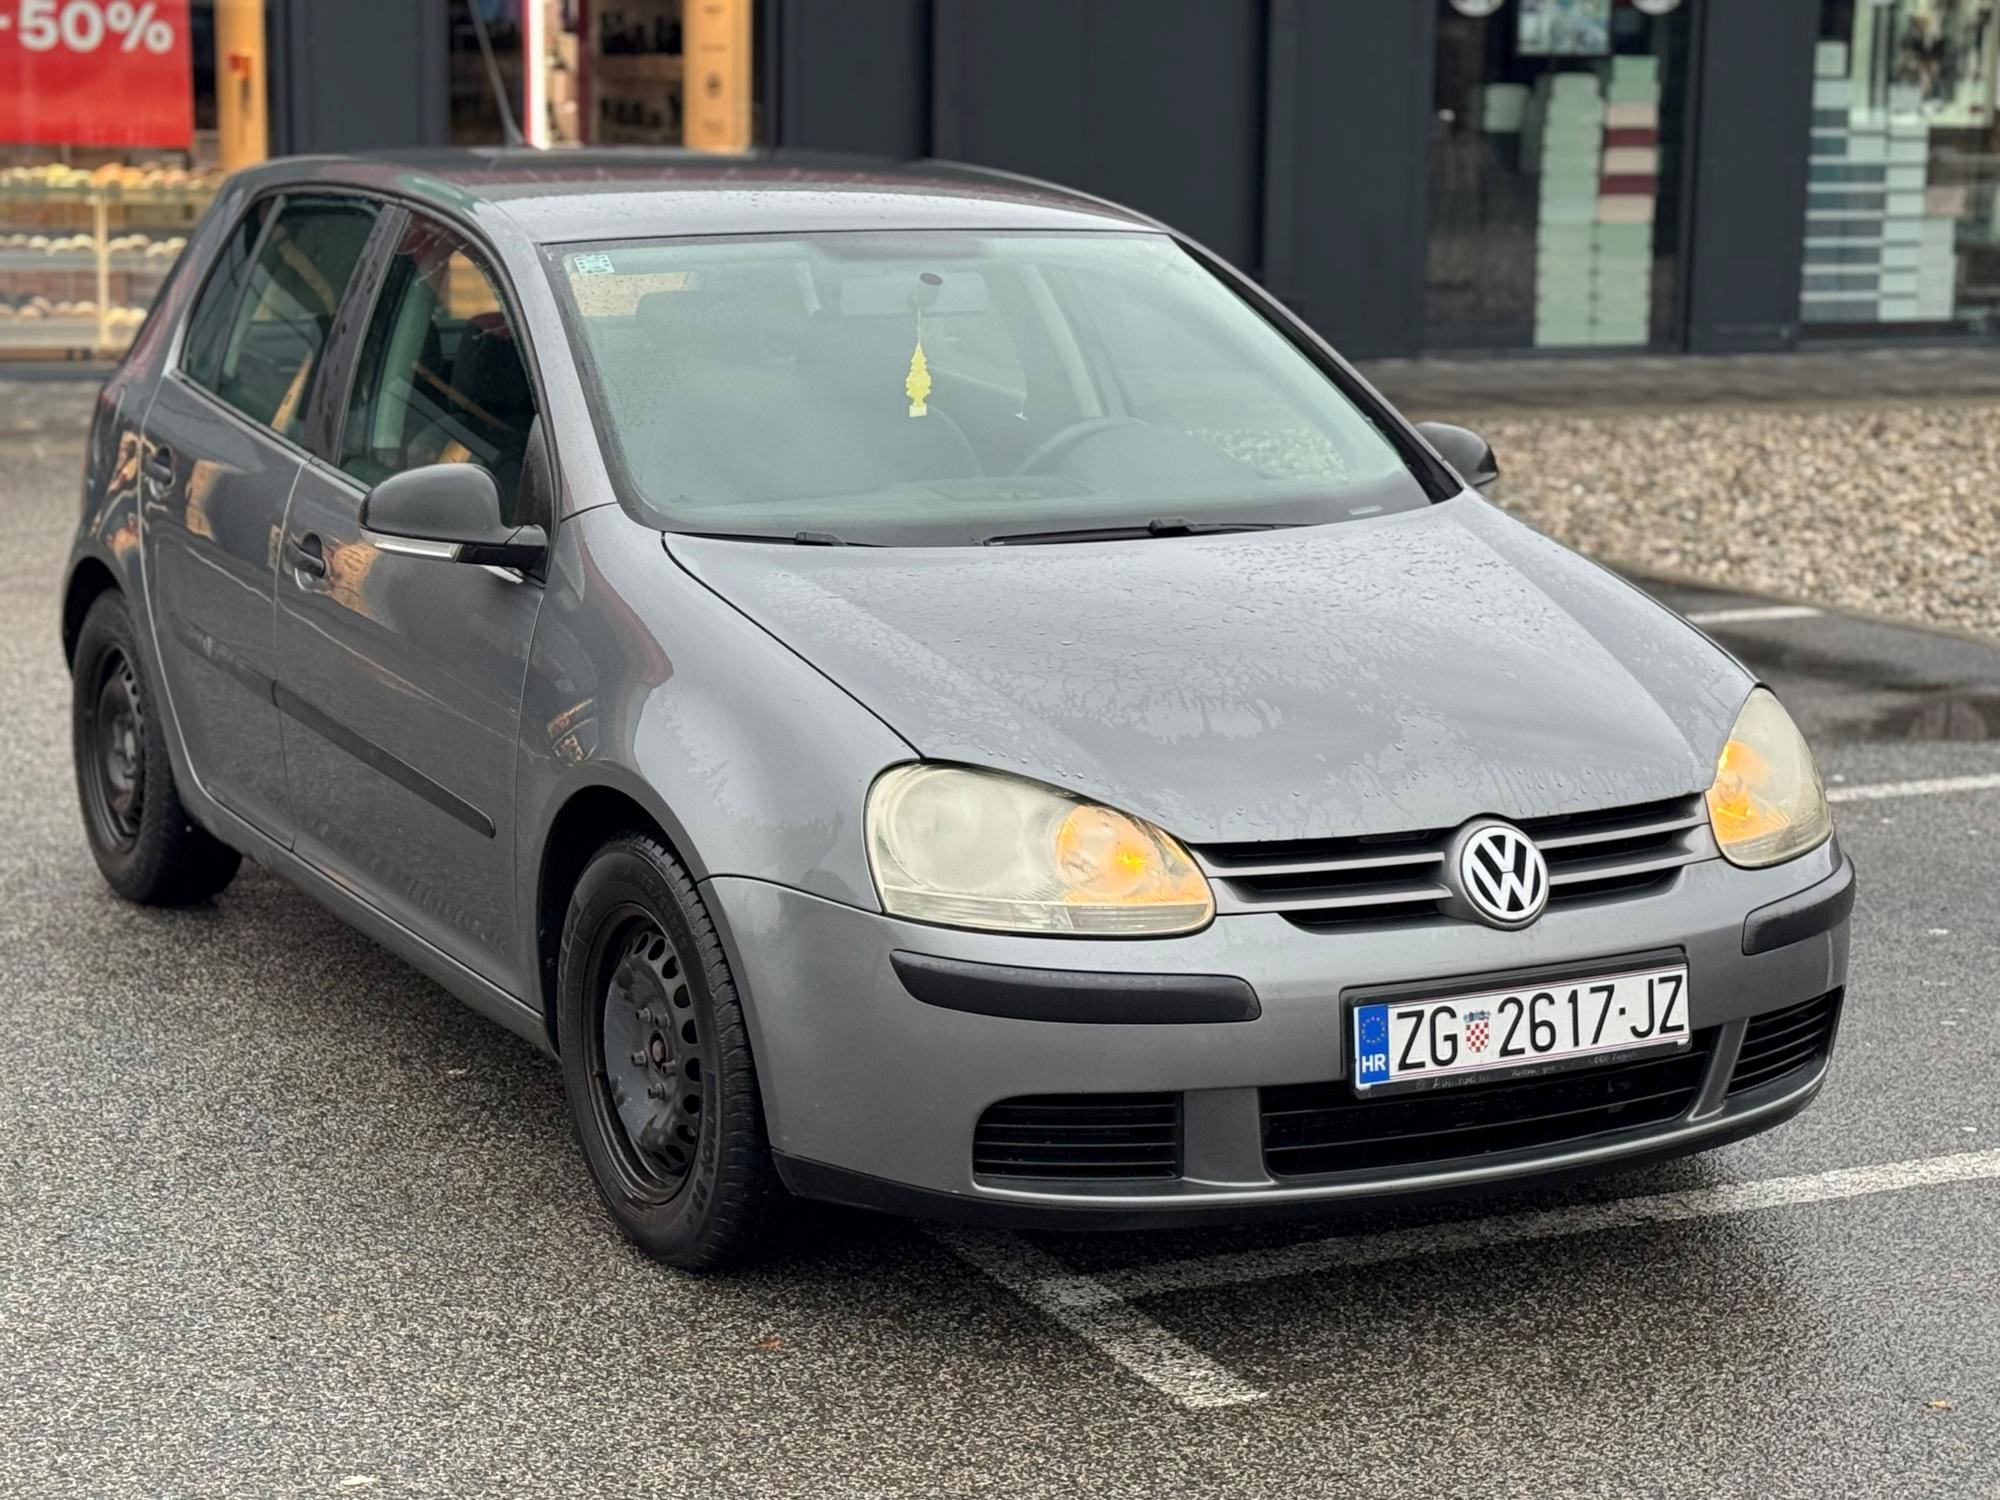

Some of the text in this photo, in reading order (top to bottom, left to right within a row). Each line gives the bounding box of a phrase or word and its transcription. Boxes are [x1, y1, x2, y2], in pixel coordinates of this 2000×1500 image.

[0, 0, 175, 54] -50%
[1463, 826, 1547, 920] VW
[1361, 1053, 1387, 1074] HR
[1397, 1005, 1459, 1072] ZG
